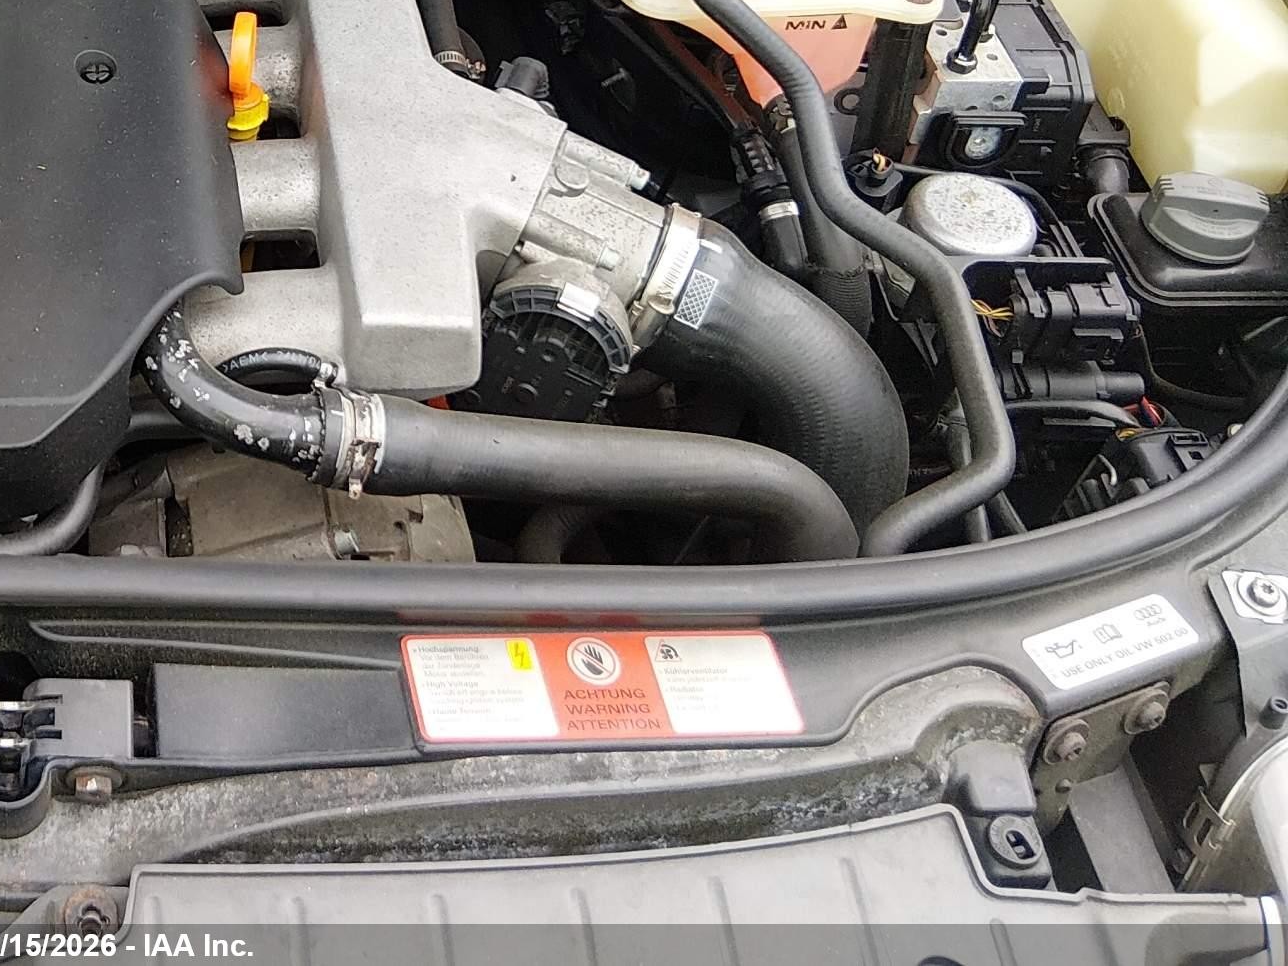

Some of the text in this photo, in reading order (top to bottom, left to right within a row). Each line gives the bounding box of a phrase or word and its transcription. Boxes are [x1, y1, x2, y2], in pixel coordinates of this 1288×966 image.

[785, 20, 826, 31] MIN
[1061, 665, 1084, 678] USE
[1084, 654, 1113, 670] ONLY
[1115, 648, 1134, 659] OIL
[1134, 639, 1154, 651] VW
[564, 688, 646, 701] ACHTUNG
[566, 703, 651, 716] WARNING
[567, 718, 661, 732] ATTENTION
